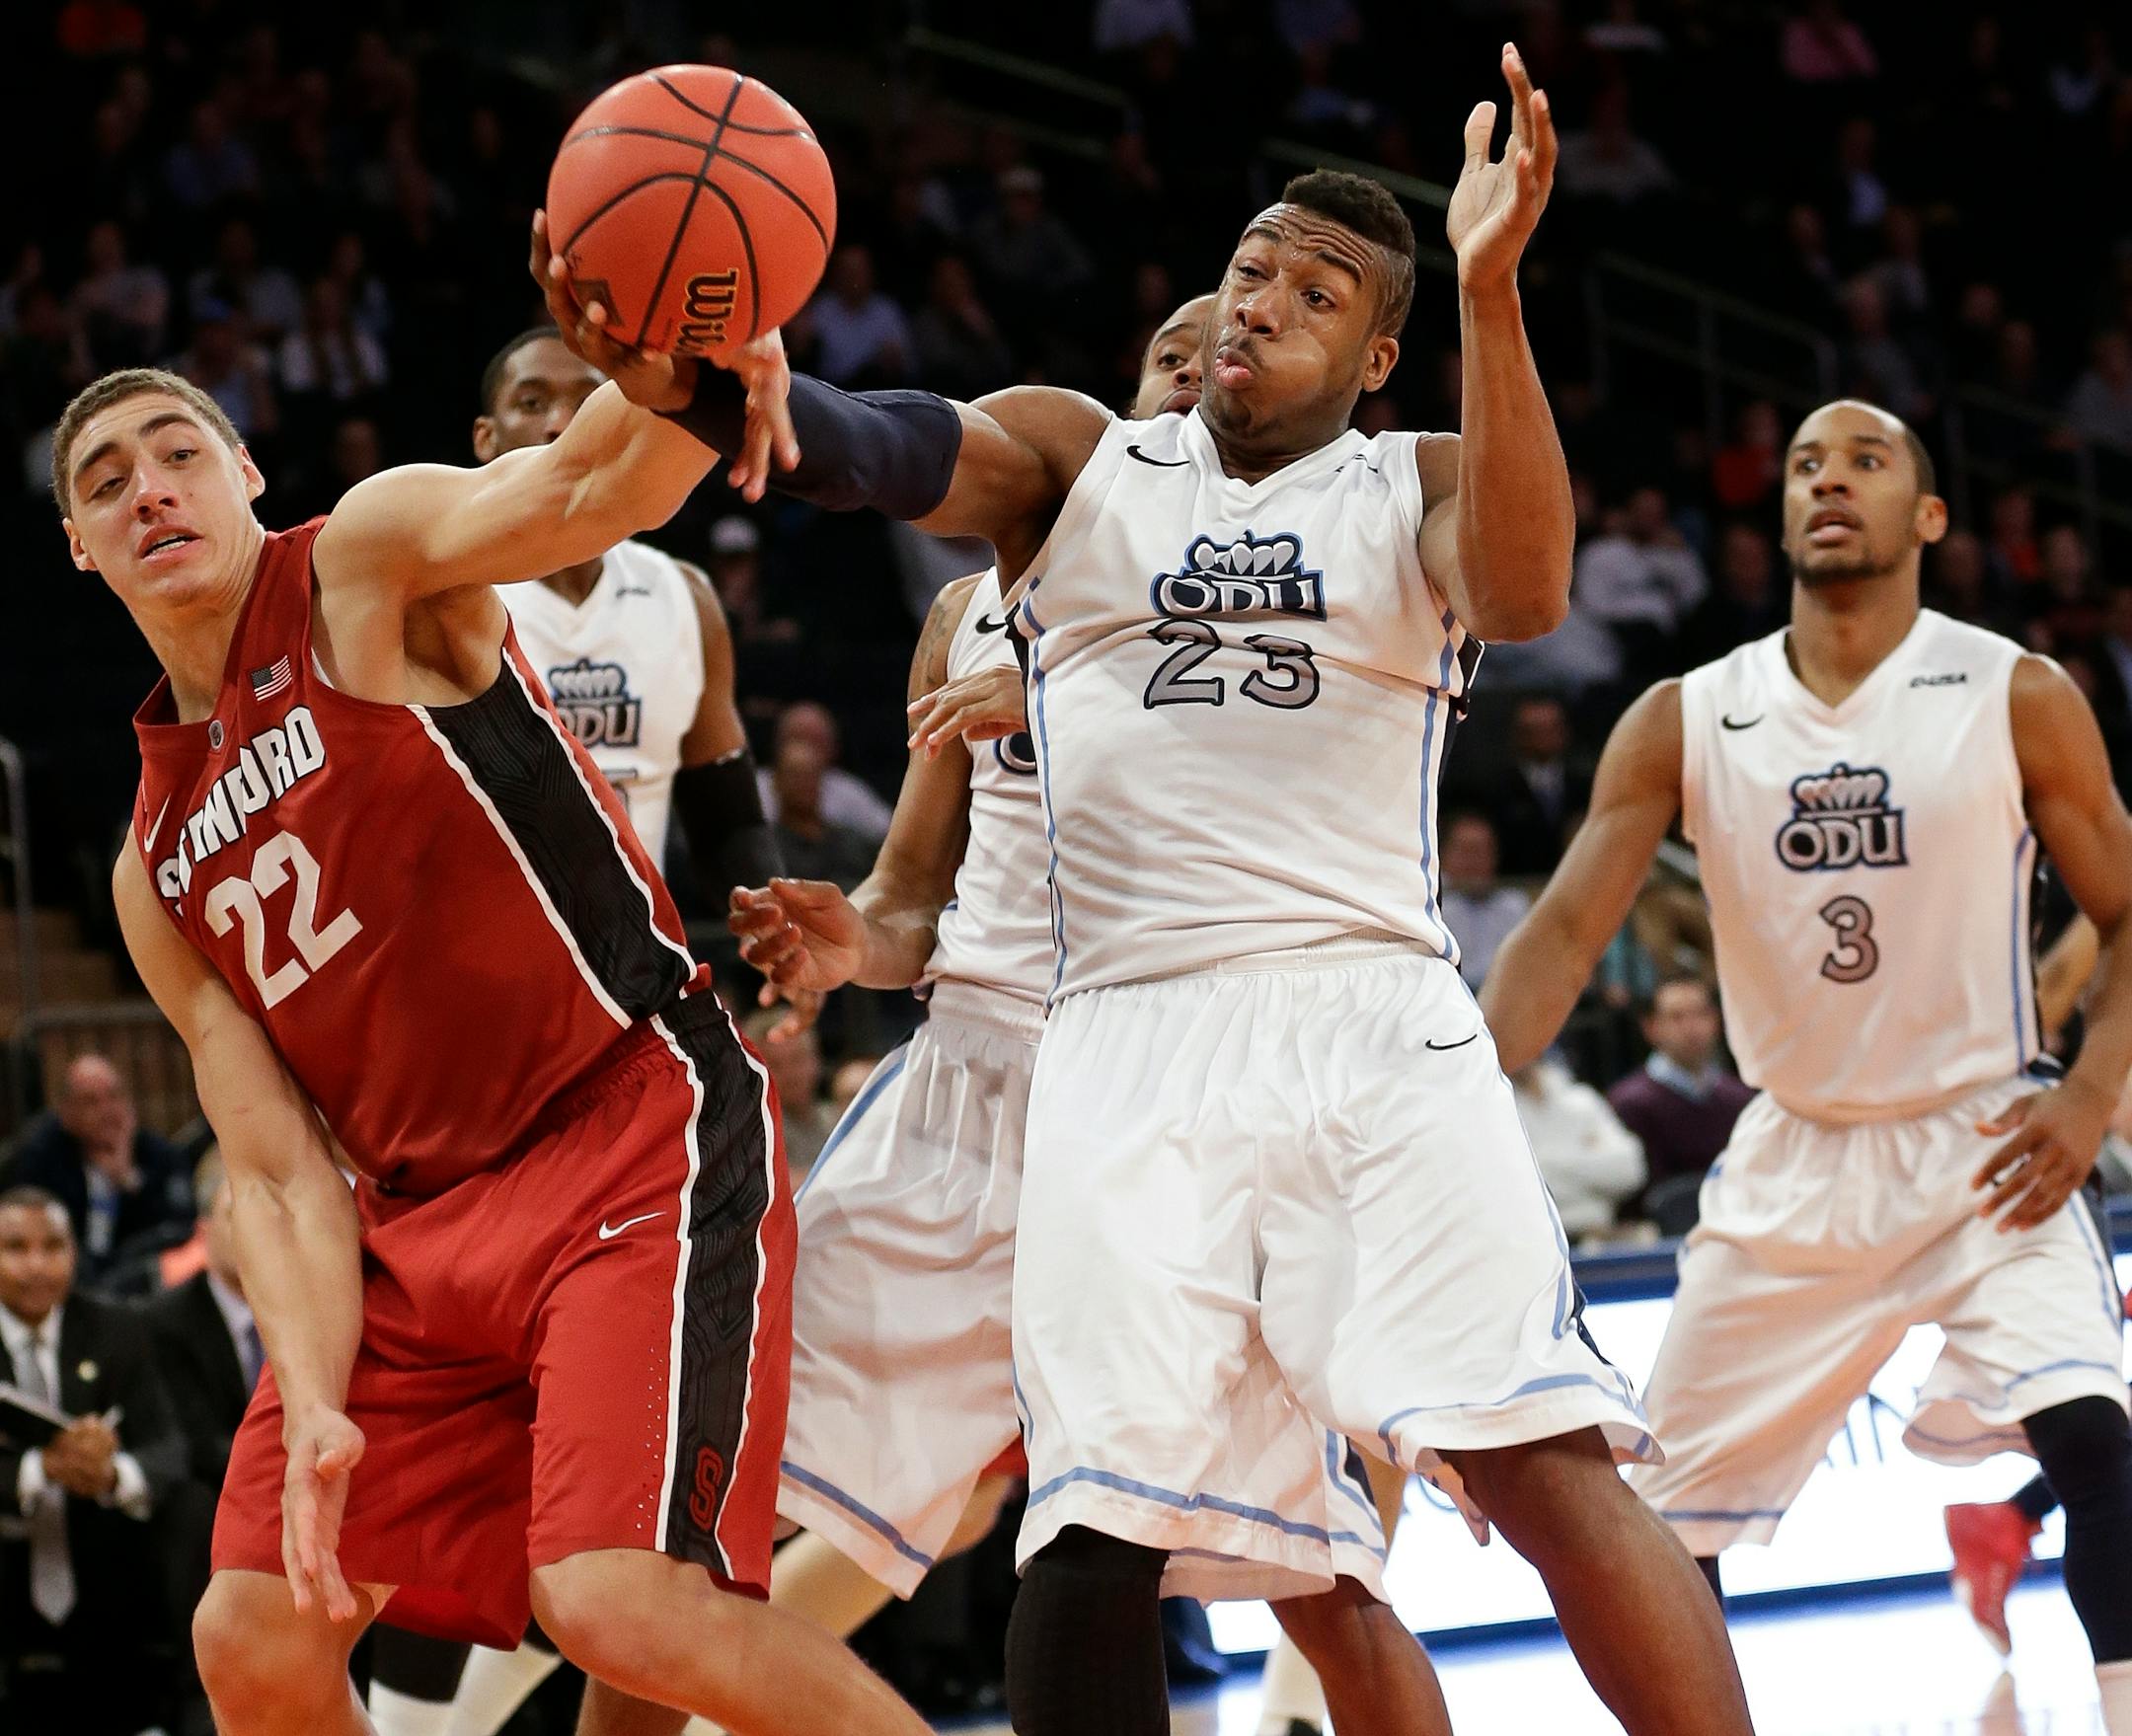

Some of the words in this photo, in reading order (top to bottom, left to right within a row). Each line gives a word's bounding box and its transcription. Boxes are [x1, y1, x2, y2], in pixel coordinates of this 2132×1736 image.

[678, 267, 739, 349] Wil
[1154, 566, 1324, 620] ODU
[1143, 617, 1321, 710] 23
[1776, 810, 1907, 870] ODU
[204, 830, 363, 1011] 22
[1819, 894, 1879, 983] 3
[690, 1447, 723, 1531] S
